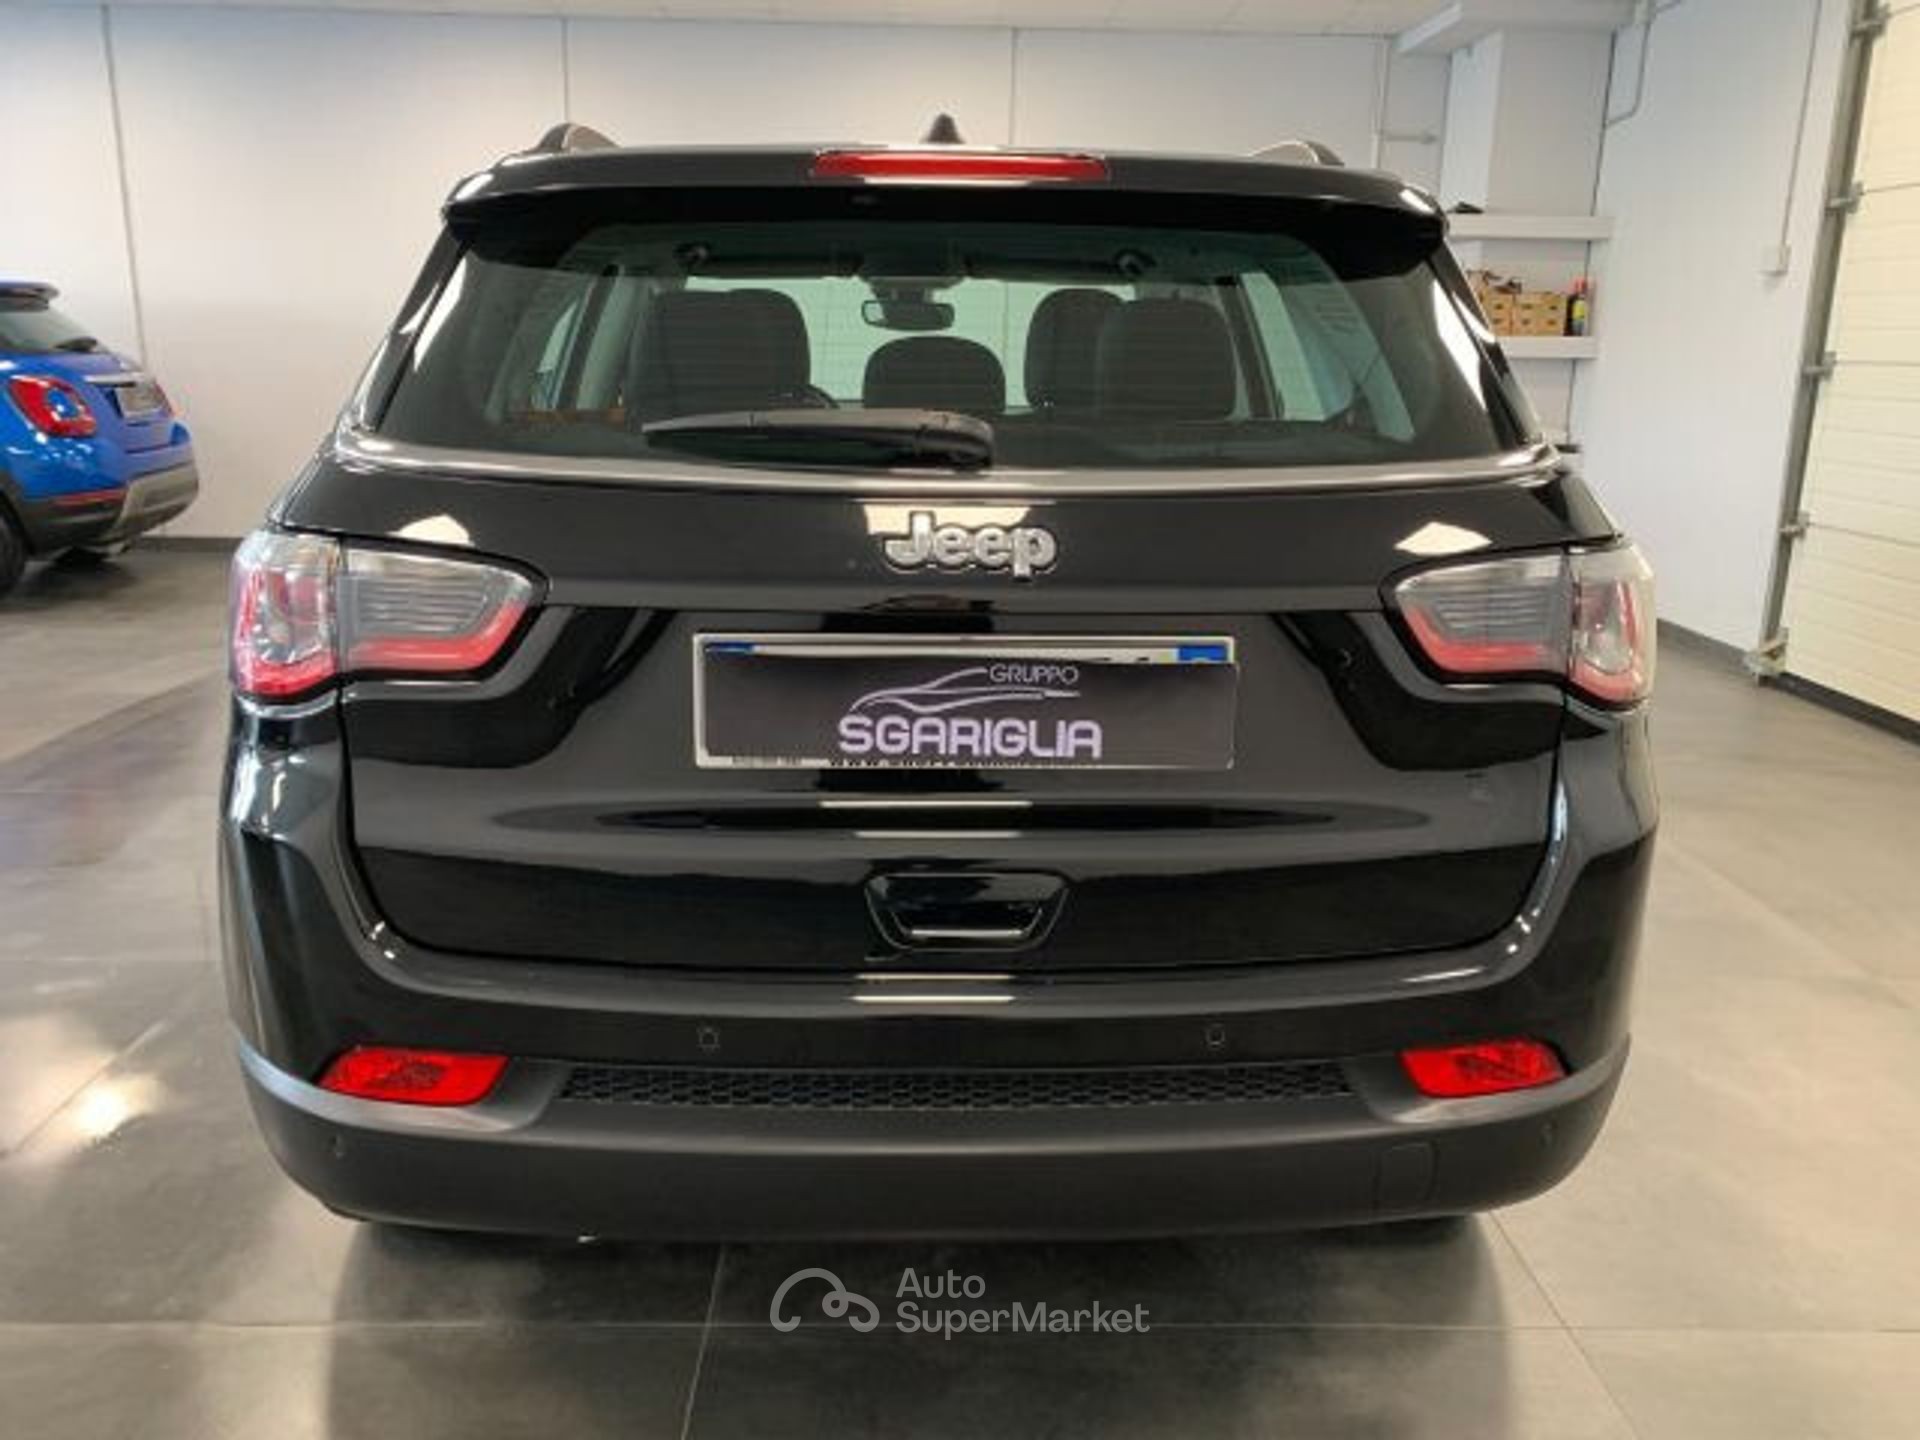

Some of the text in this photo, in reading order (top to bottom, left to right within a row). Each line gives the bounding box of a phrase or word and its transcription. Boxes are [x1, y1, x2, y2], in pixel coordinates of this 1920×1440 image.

[884, 512, 1057, 577] Jeep
[989, 663, 1080, 685] GRUPPO
[838, 714, 1102, 759] SGARIGLIA
